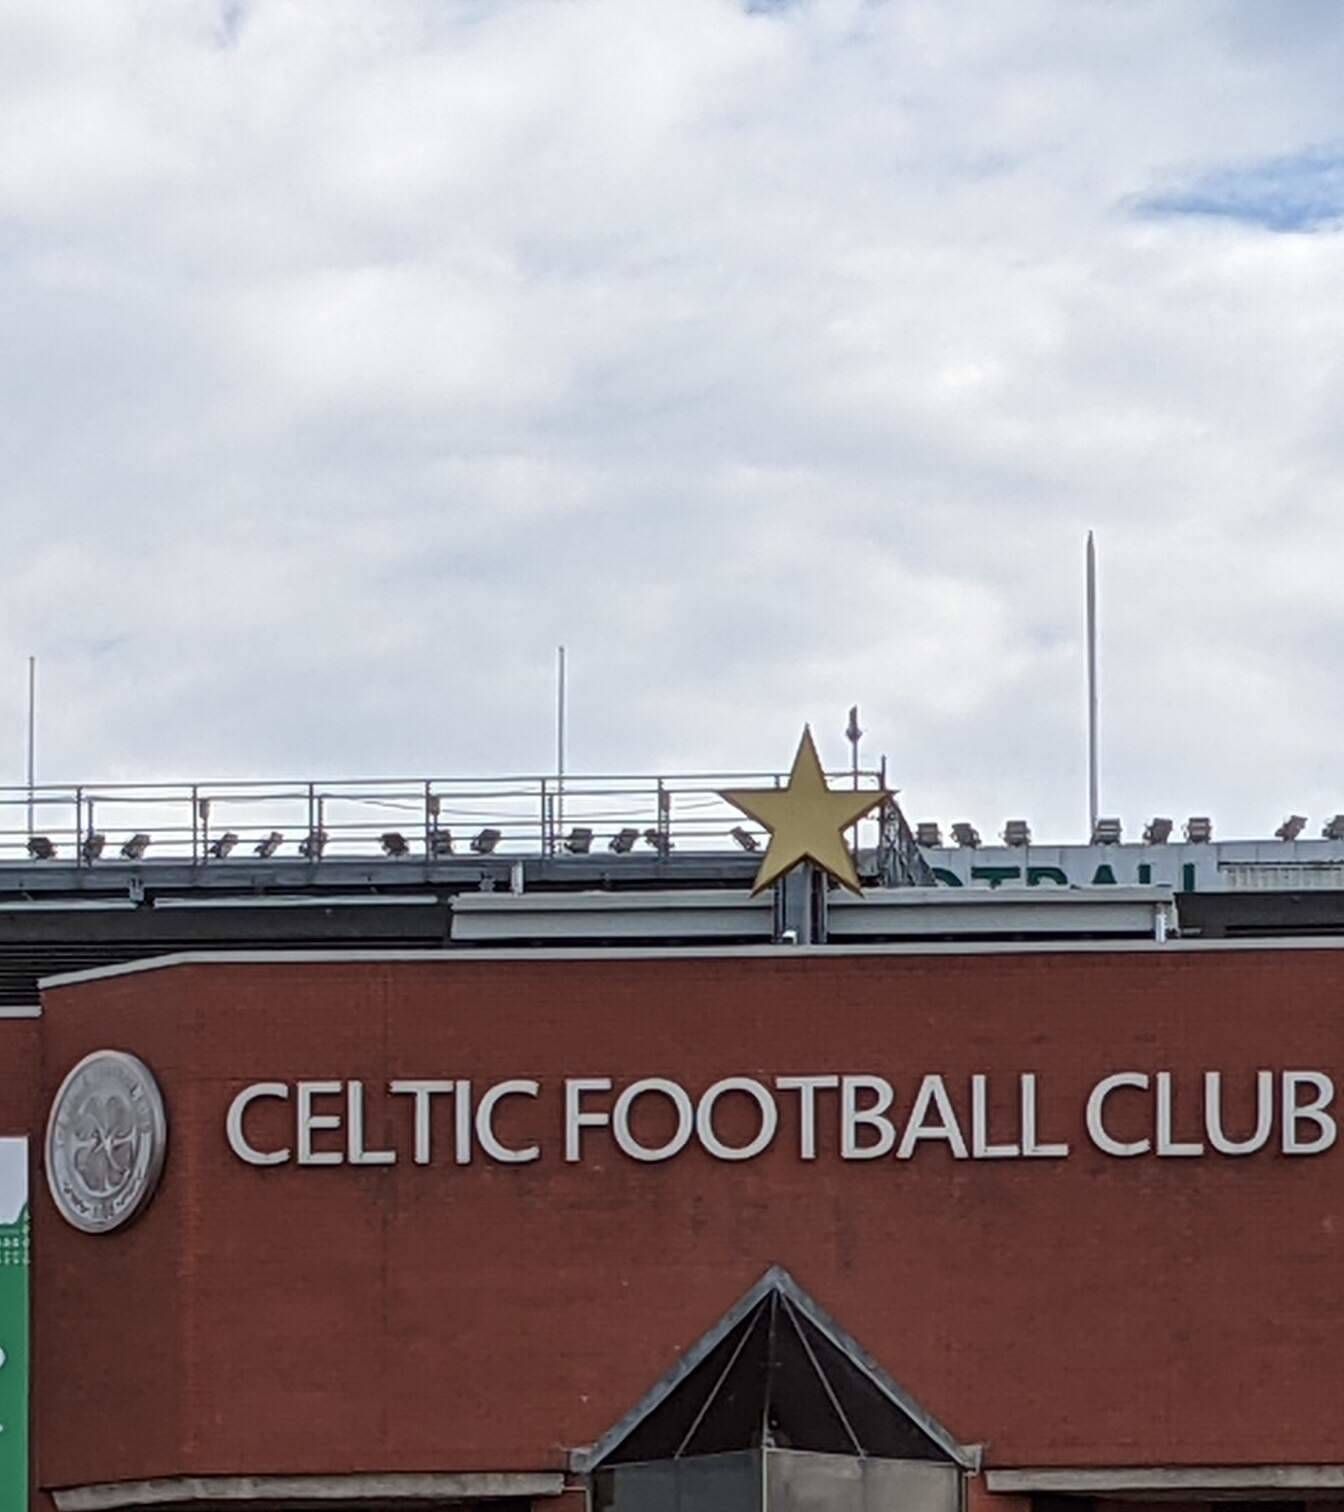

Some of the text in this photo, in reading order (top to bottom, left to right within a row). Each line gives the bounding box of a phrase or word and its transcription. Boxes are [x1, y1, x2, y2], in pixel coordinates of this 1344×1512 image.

[226, 1079, 541, 1165] CELTIC
[565, 1075, 1069, 1162] FOOTBALL
[1086, 1071, 1338, 1157] CLUB
